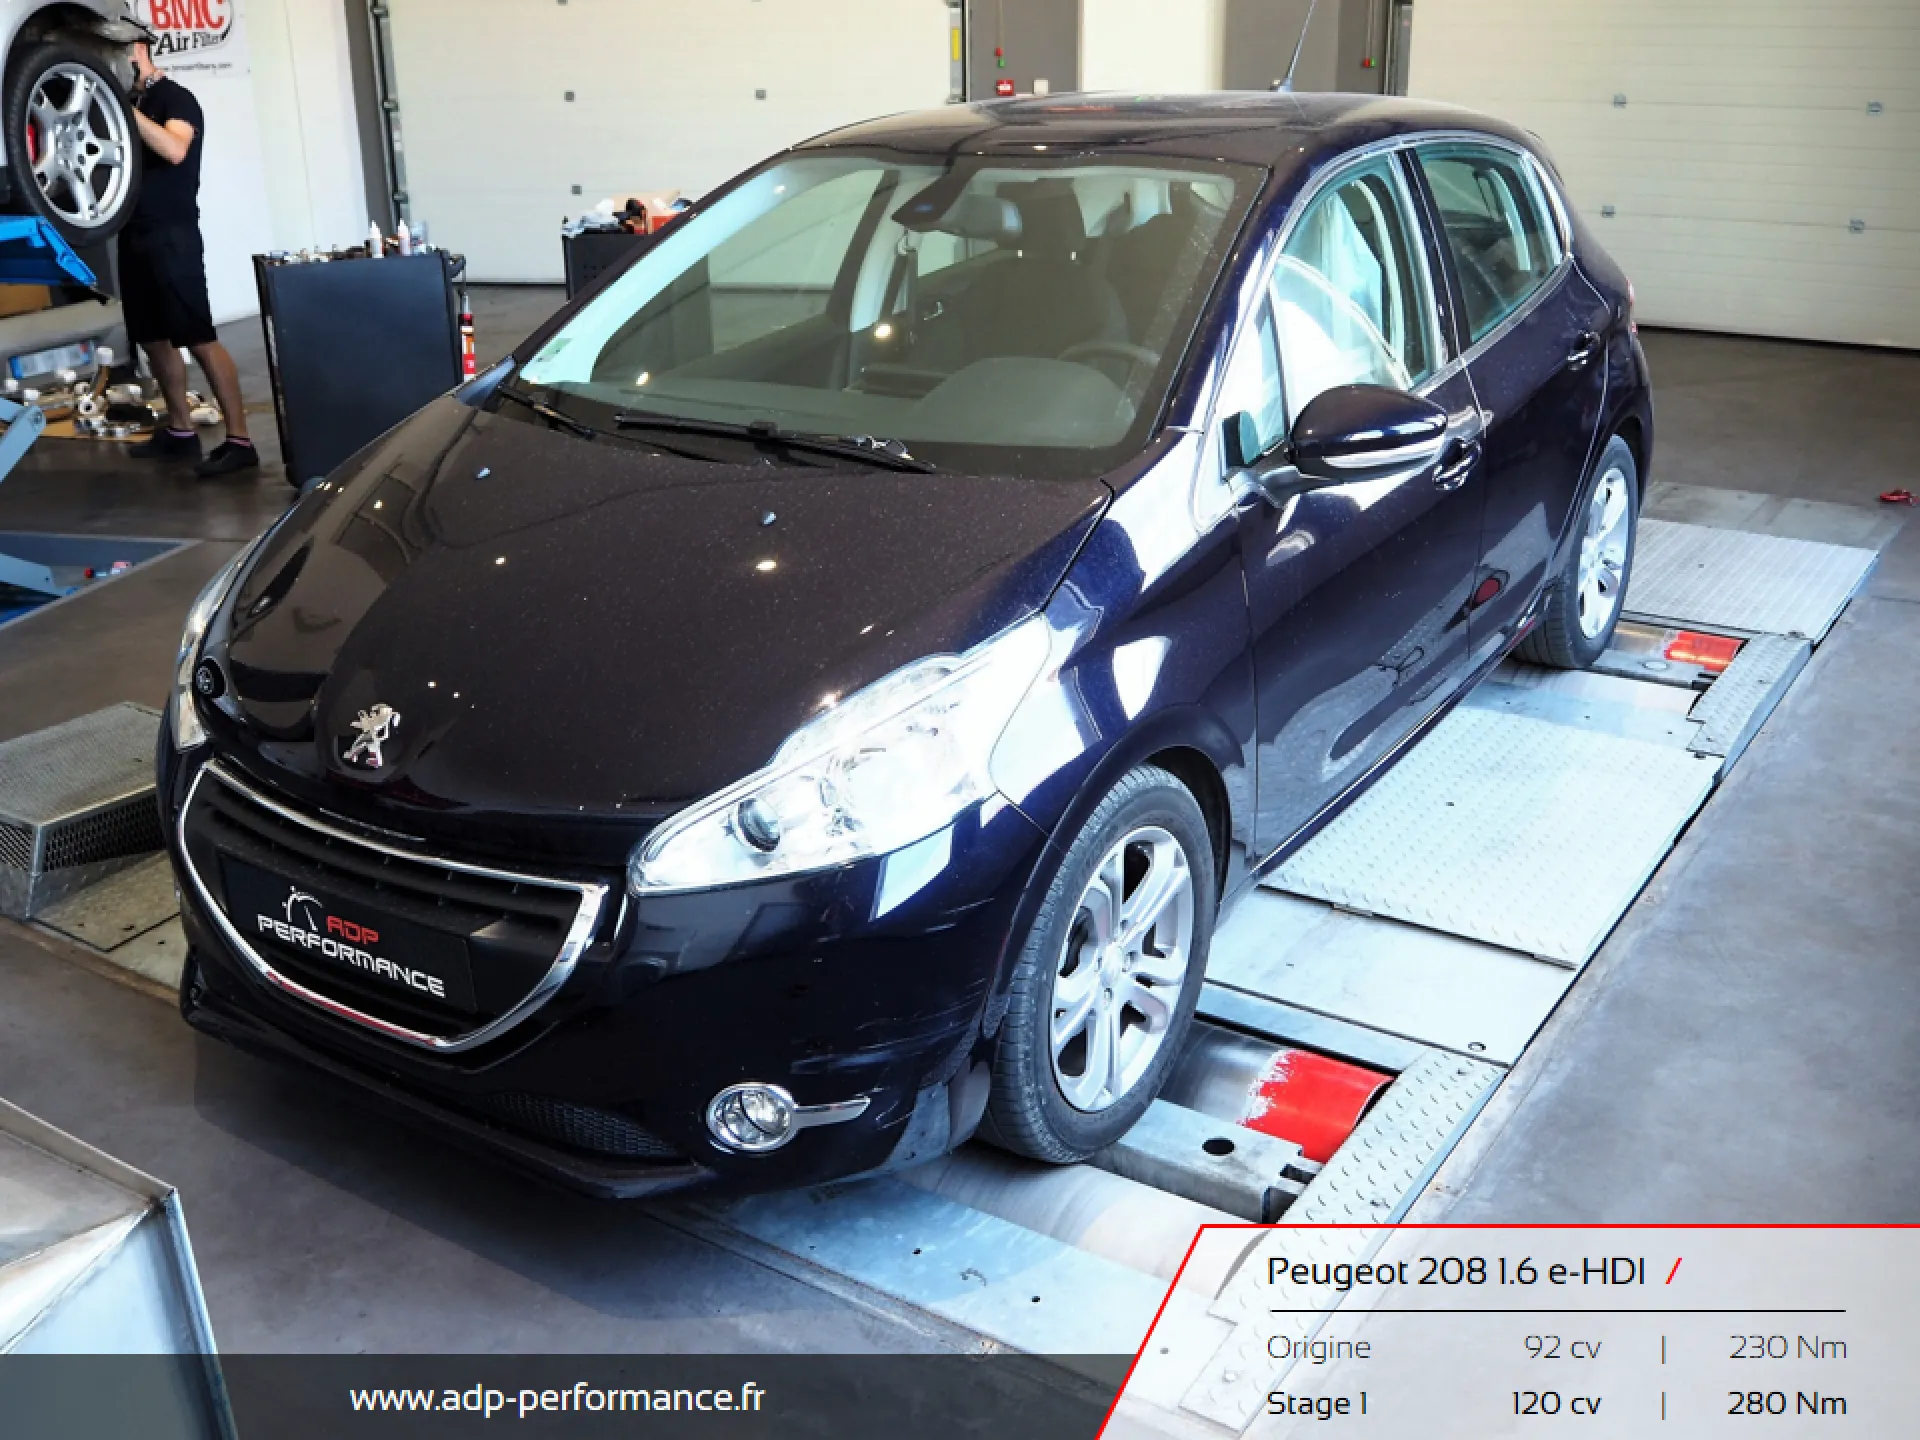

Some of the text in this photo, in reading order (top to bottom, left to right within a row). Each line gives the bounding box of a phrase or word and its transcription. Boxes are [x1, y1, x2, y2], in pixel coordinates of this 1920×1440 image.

[149, 0, 225, 30] BMC
[154, 31, 190, 56] Air
[326, 915, 379, 944] ADP
[257, 913, 446, 999] PERFORMANCE
